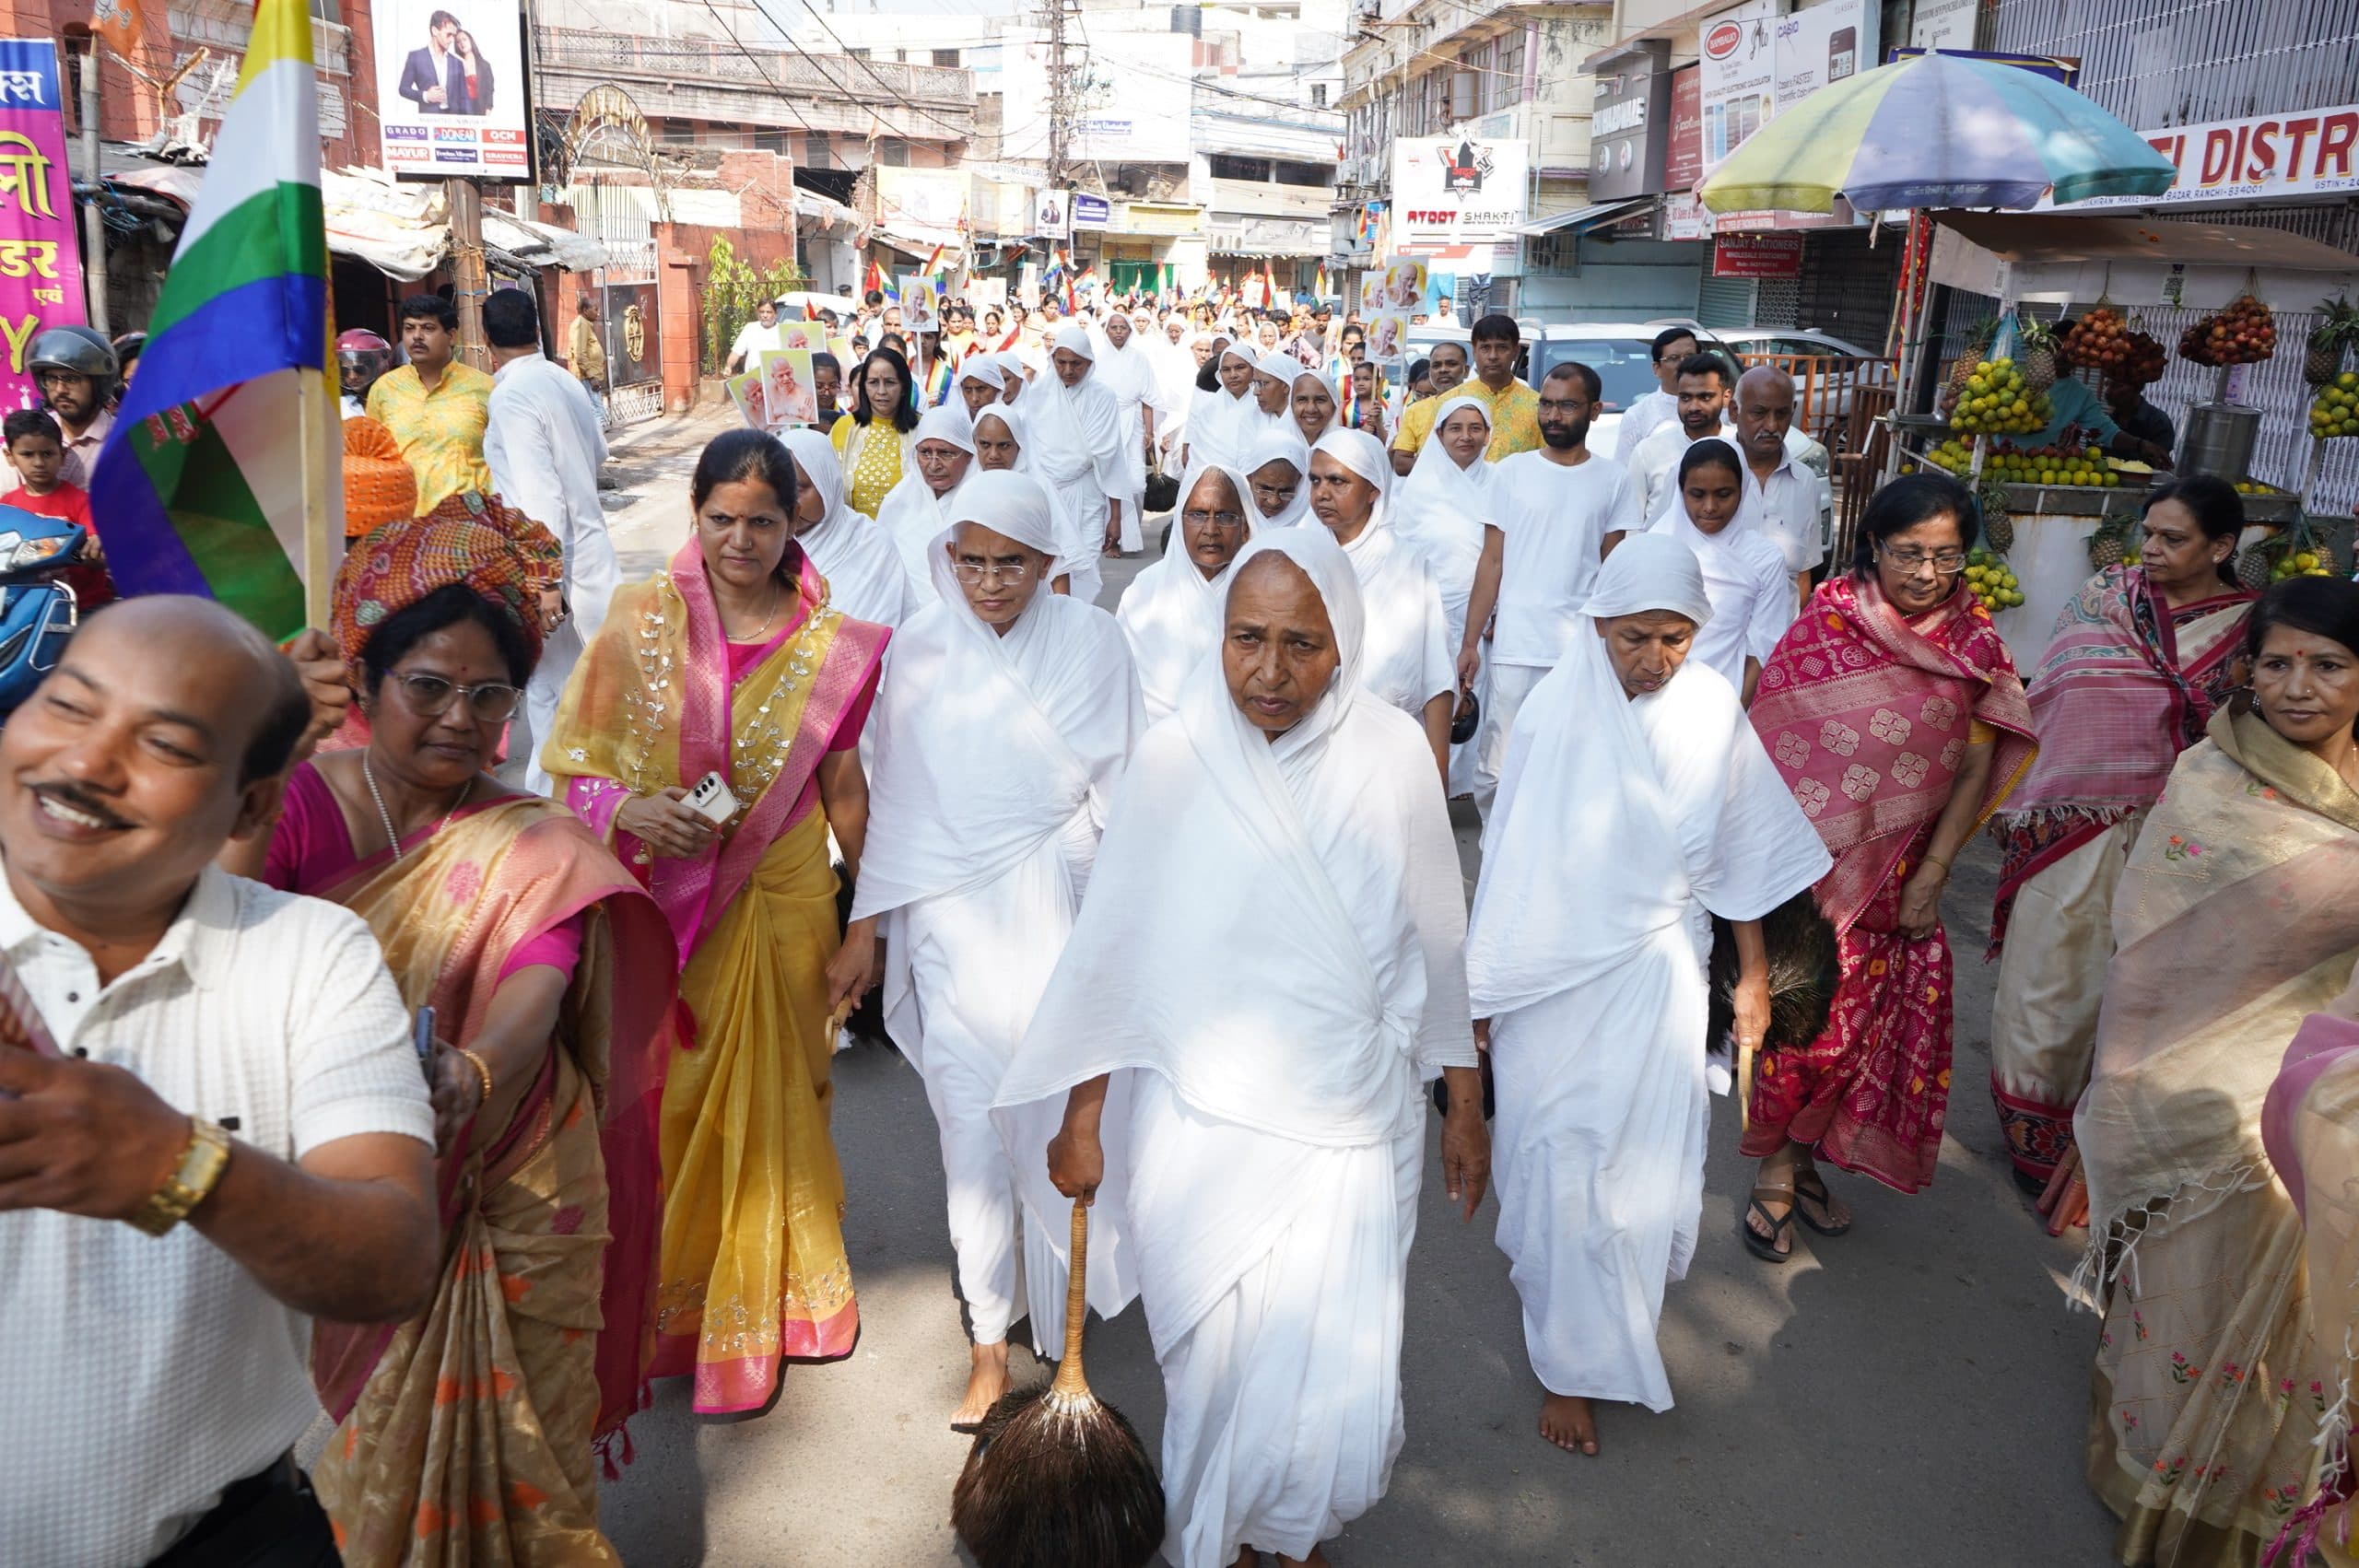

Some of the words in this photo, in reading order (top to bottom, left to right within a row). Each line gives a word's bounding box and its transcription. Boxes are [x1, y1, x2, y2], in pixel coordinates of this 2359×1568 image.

[1777, 20, 1799, 38] CASIO
[386, 126, 426, 135] GRADO
[441, 128, 475, 141] DONEAR
[490, 131, 516, 141] OCM
[386, 146, 428, 158] MAYUR
[2201, 111, 2359, 188] DISTR
[1719, 238, 1749, 249] SANJAY
[1752, 240, 1799, 251] STATIONERS
[32, 284, 64, 306] एवं
